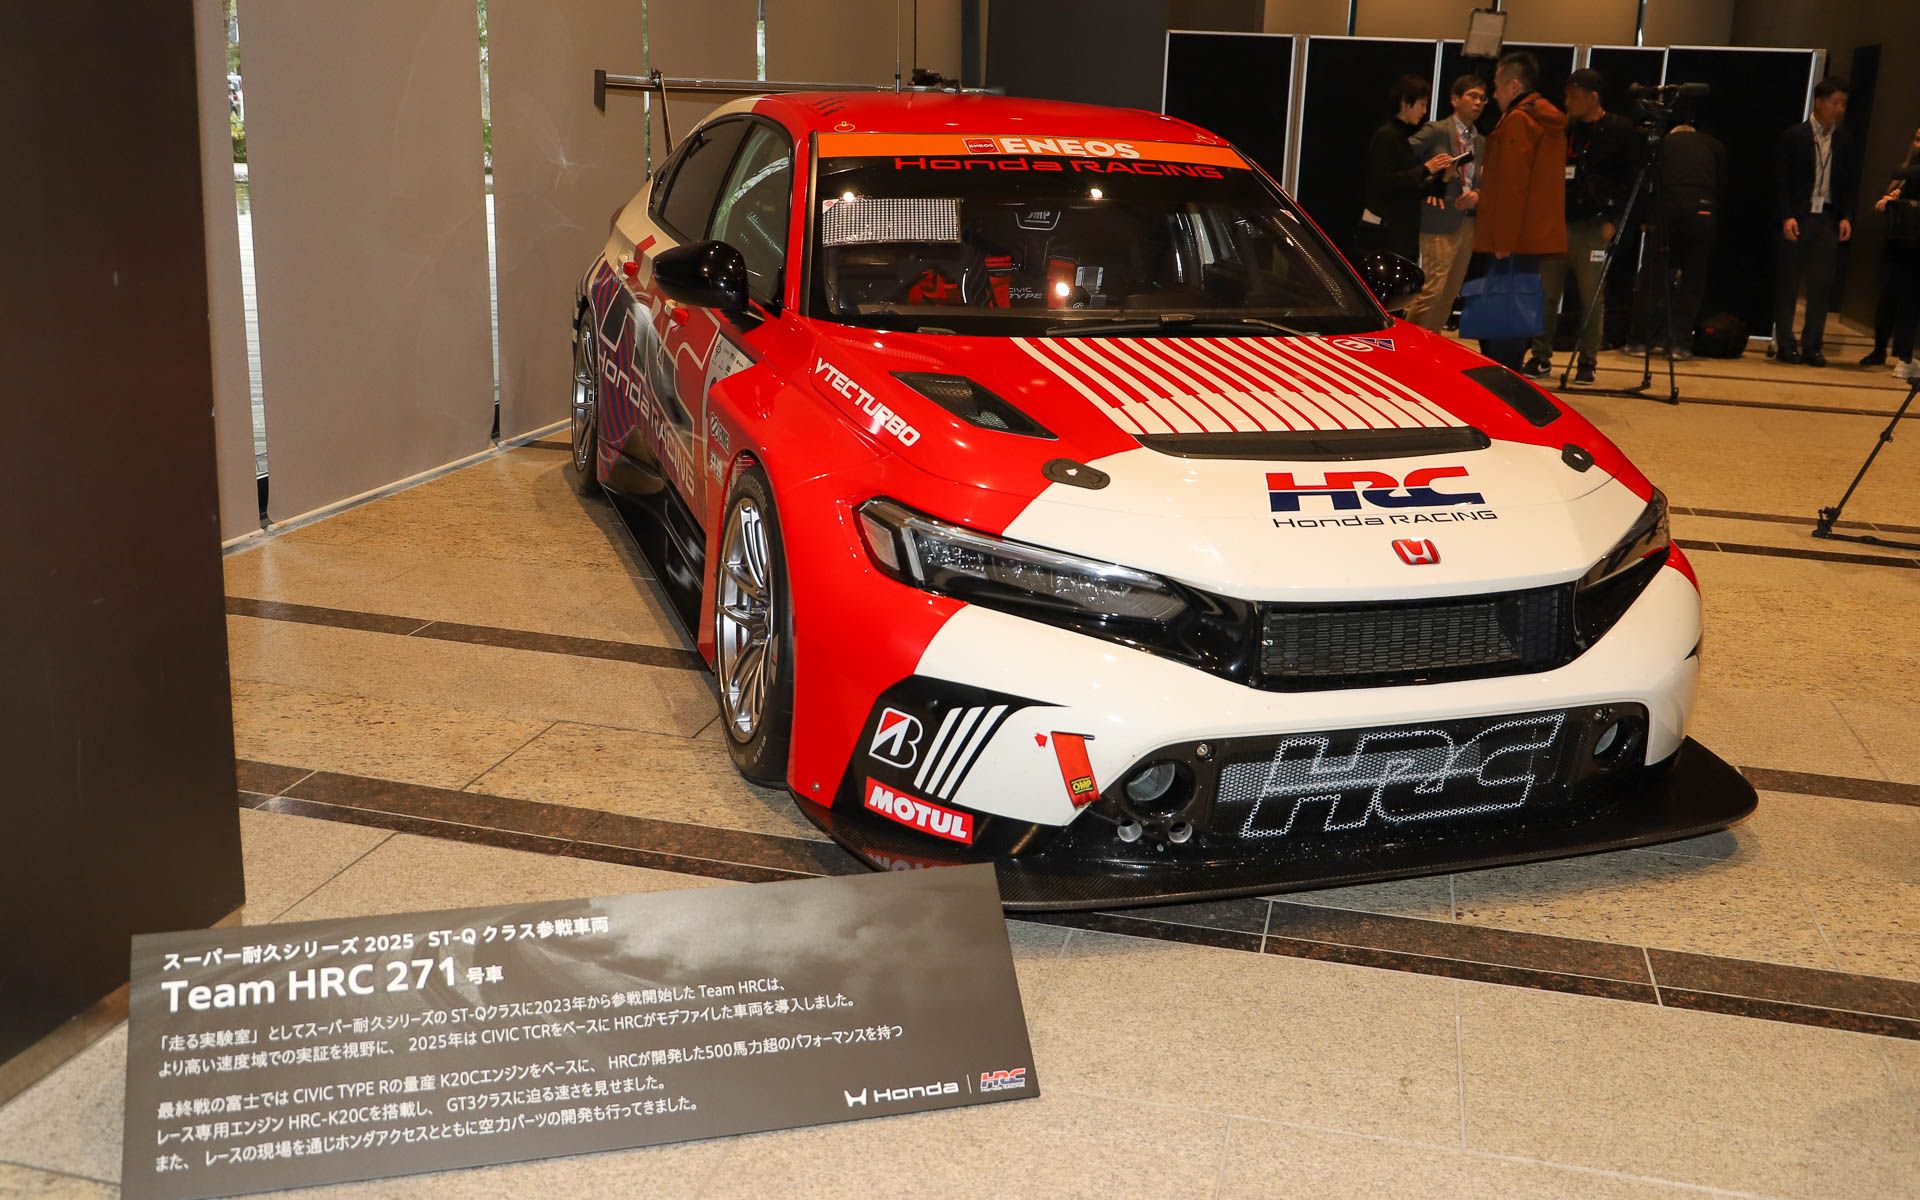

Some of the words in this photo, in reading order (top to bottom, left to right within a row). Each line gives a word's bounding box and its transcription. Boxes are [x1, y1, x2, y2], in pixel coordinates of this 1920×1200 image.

[1000, 137, 1140, 159] ENEOS
[894, 156, 1061, 172] Honda
[1071, 160, 1224, 179] RACING
[1266, 466, 1485, 512] HRC
[1273, 513, 1385, 529] Honda
[1392, 510, 1498, 525] RACING
[1073, 780, 1093, 792] OMP
[1240, 712, 1566, 838] HRC
[869, 785, 967, 838] MOTUL
[364, 932, 416, 953] 2025
[427, 927, 478, 947] ST-Q
[160, 977, 275, 1013] Team
[287, 963, 374, 1001] HRC
[385, 954, 459, 992] 271
[466, 964, 504, 987] 号車
[696, 984, 735, 999] Team
[737, 977, 784, 994] HRCは、
[480, 1025, 519, 1044] CIVIC
[292, 1085, 334, 1104] CIVIC
[336, 1080, 375, 1099] TYPE
[378, 1073, 436, 1095] Rの量産
[981, 1068, 1026, 1089] HRC
[874, 1080, 960, 1103] Honda
